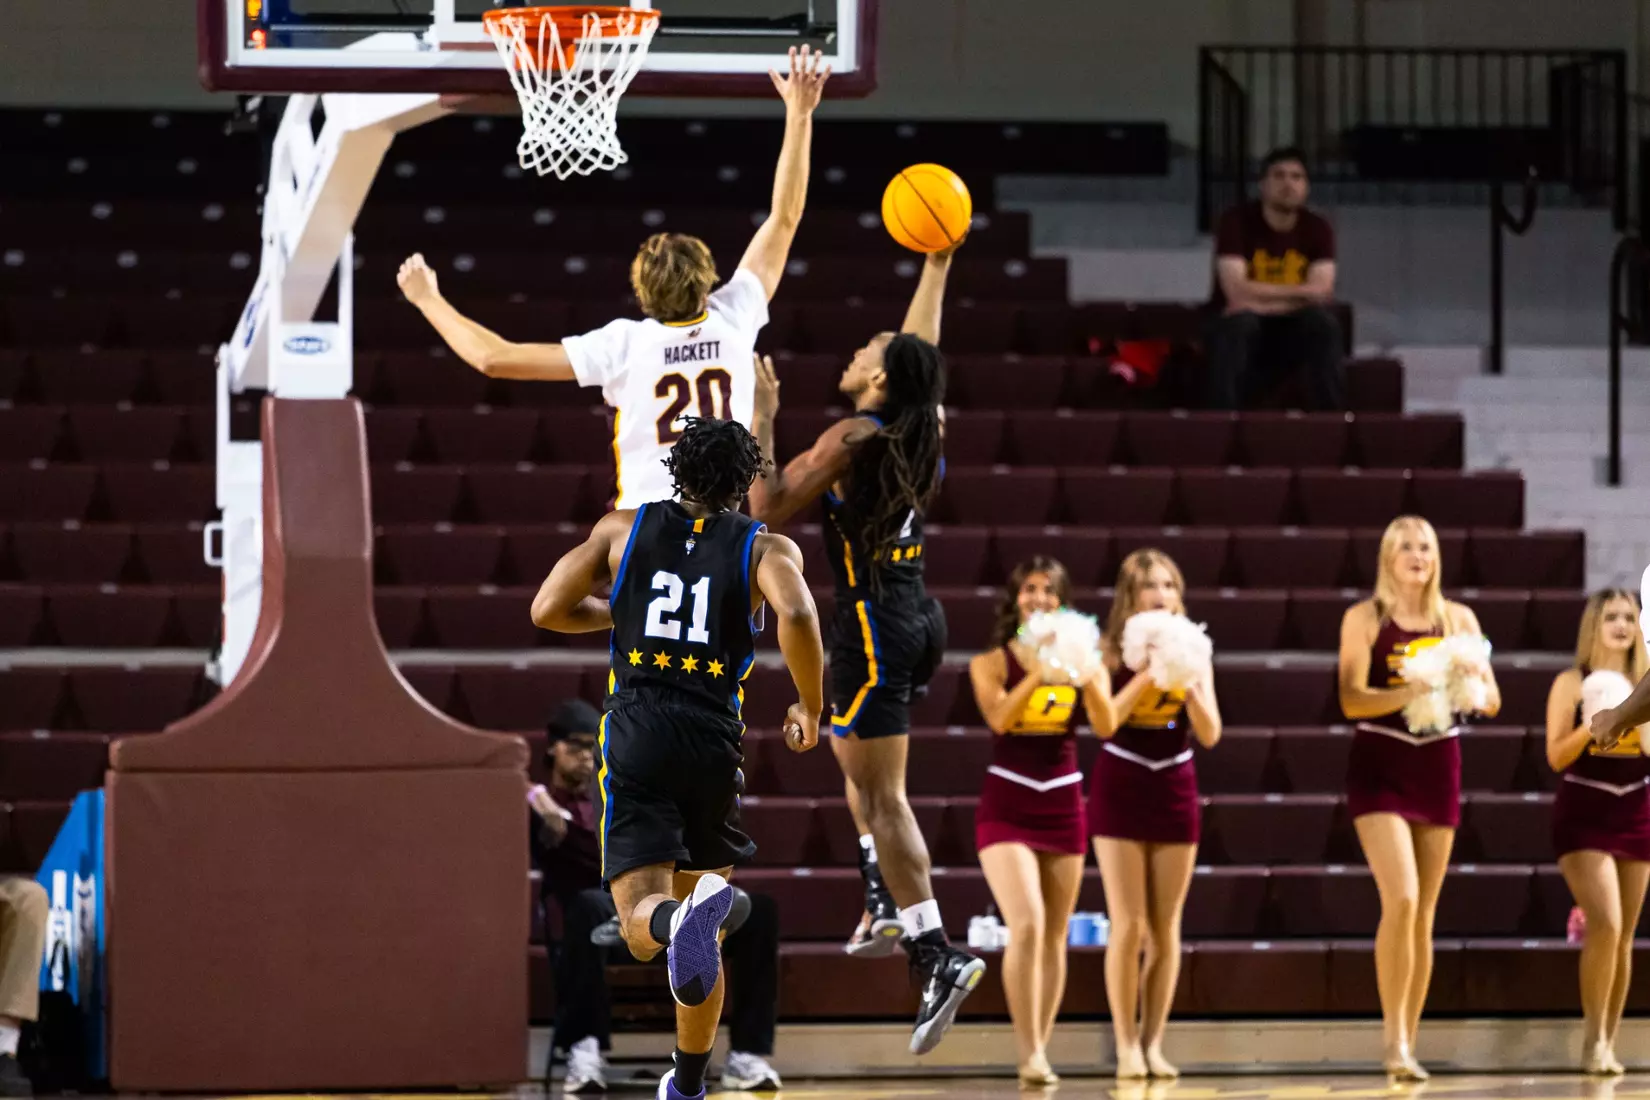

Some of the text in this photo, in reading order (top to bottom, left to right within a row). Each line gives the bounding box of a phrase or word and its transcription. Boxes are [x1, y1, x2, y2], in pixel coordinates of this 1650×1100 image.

[664, 340, 721, 365] HACKETT
[654, 367, 733, 445] 20
[643, 569, 711, 645] 21
